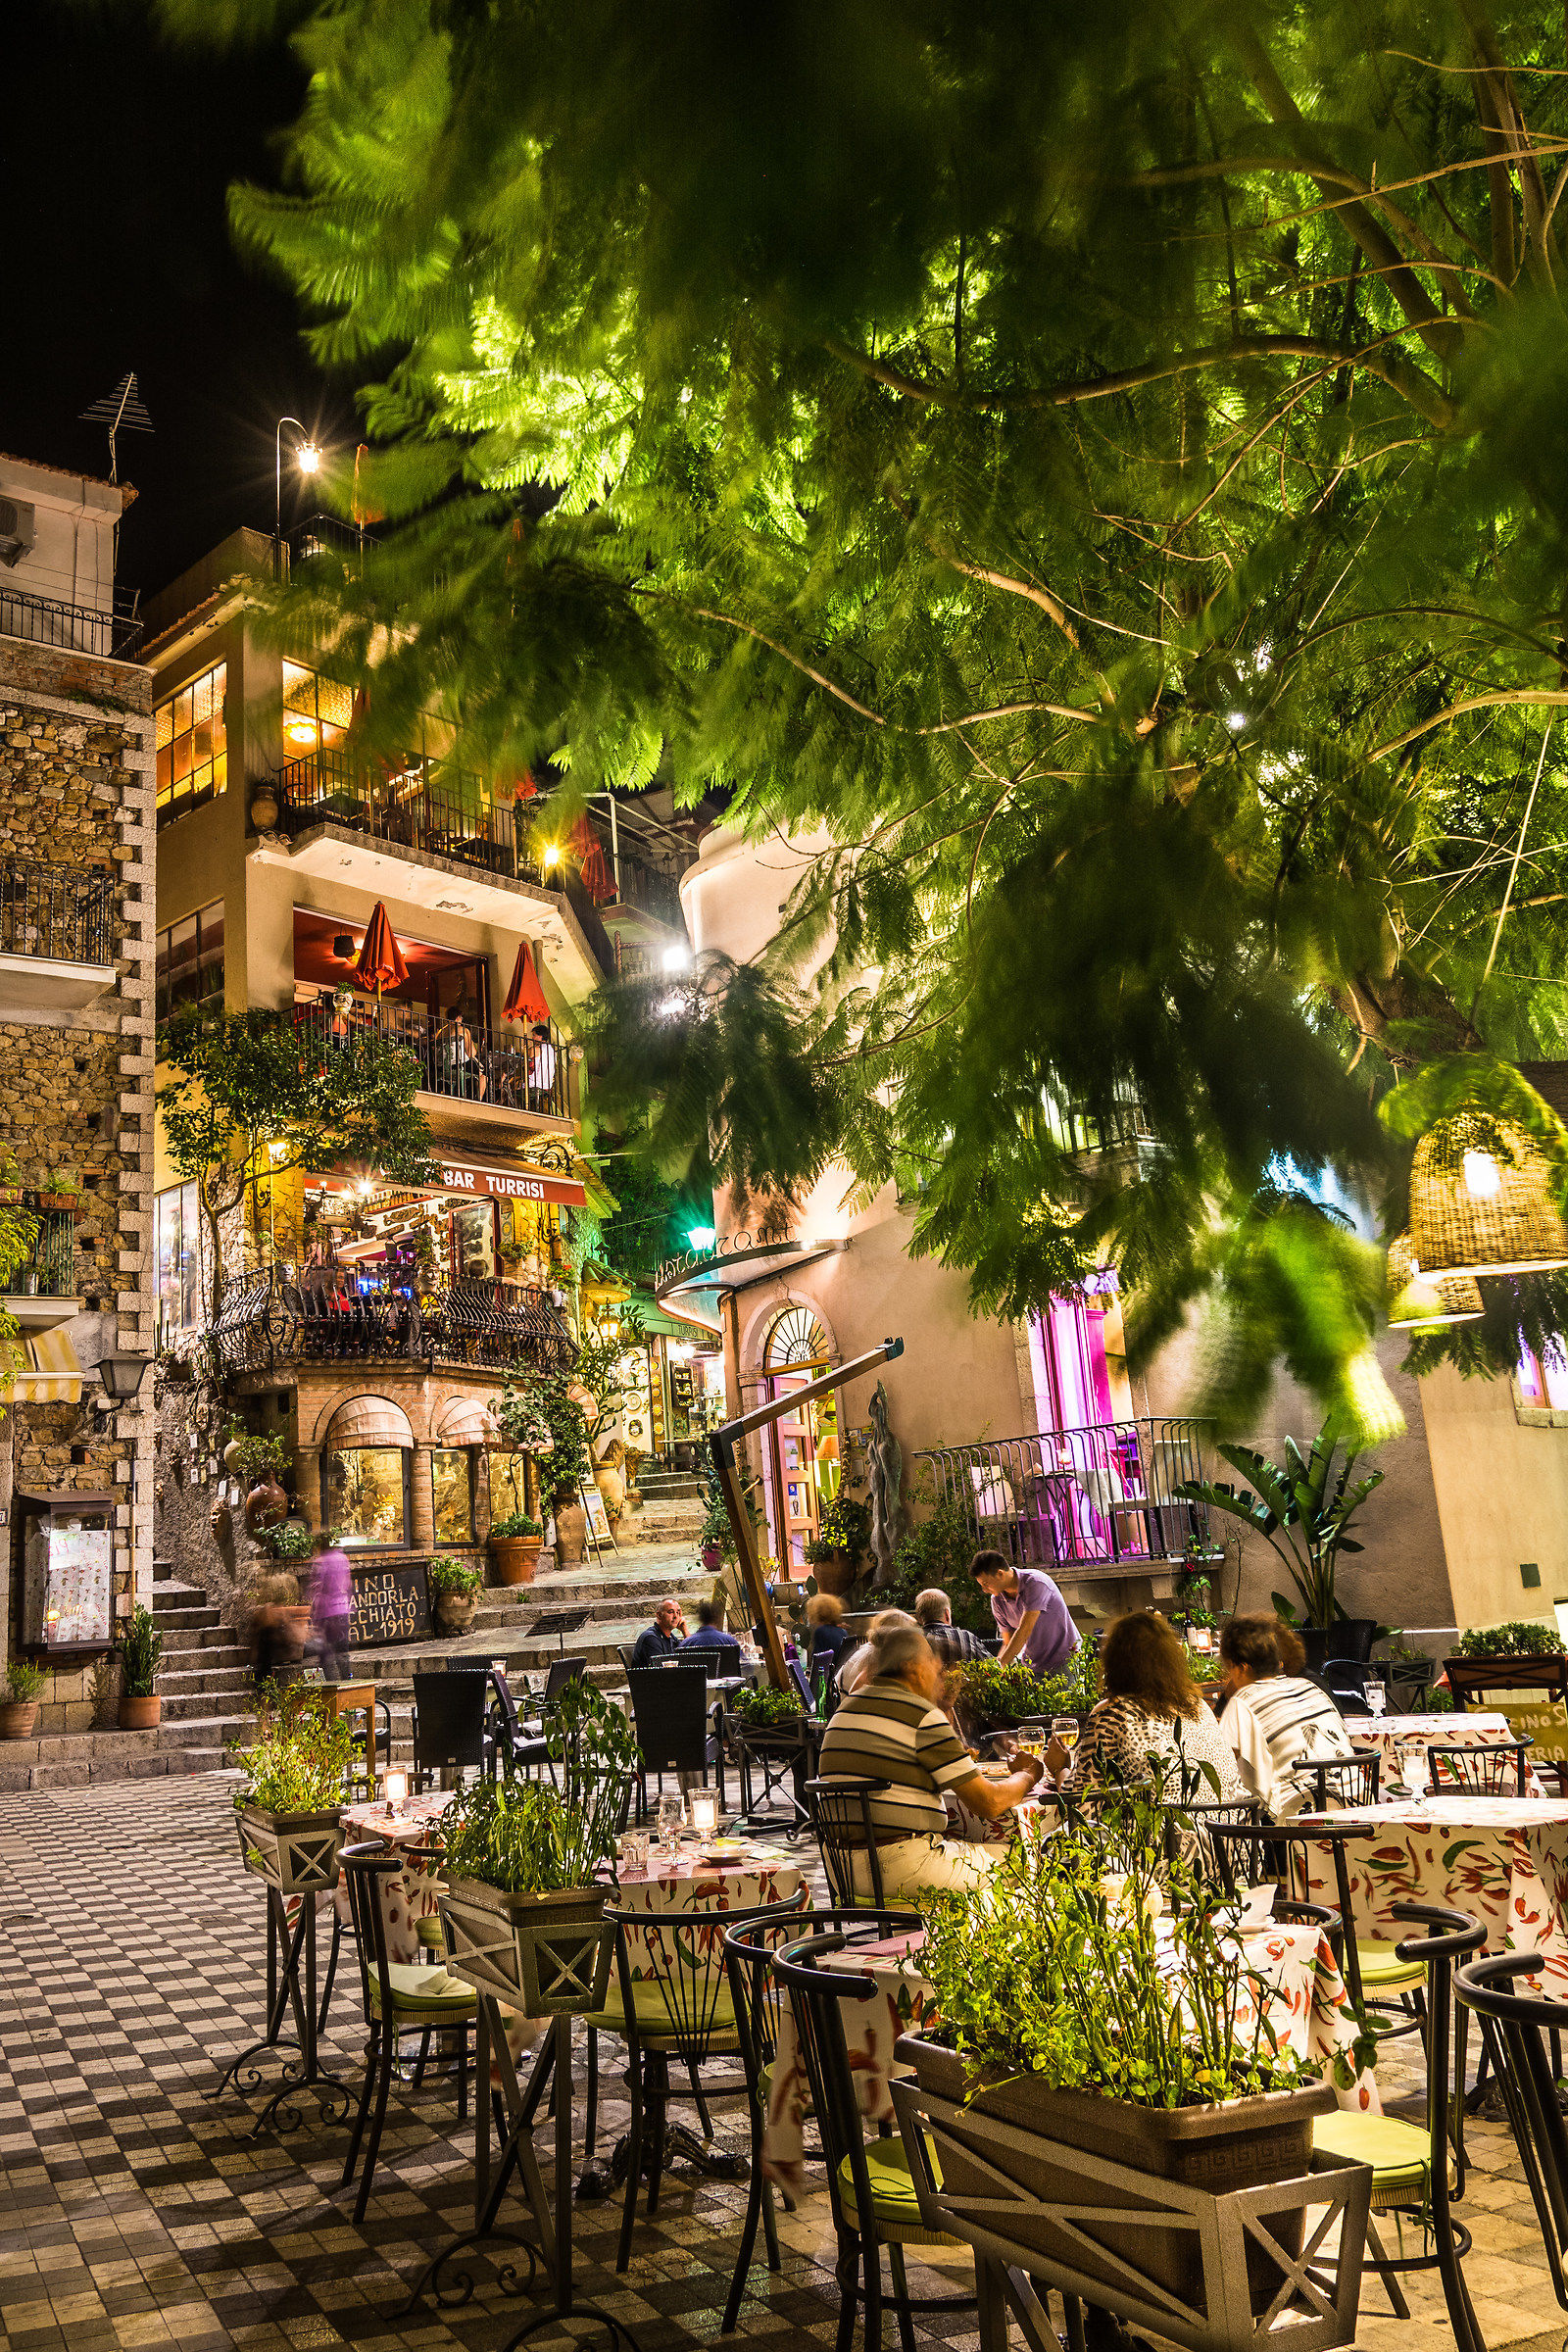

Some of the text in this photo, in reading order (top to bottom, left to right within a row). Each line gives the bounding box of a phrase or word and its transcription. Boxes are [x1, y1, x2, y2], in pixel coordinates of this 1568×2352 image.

[444, 1169, 475, 1190] BAR
[486, 1175, 545, 1199] TURRISI
[1524, 1745, 1566, 1761] ERIA
